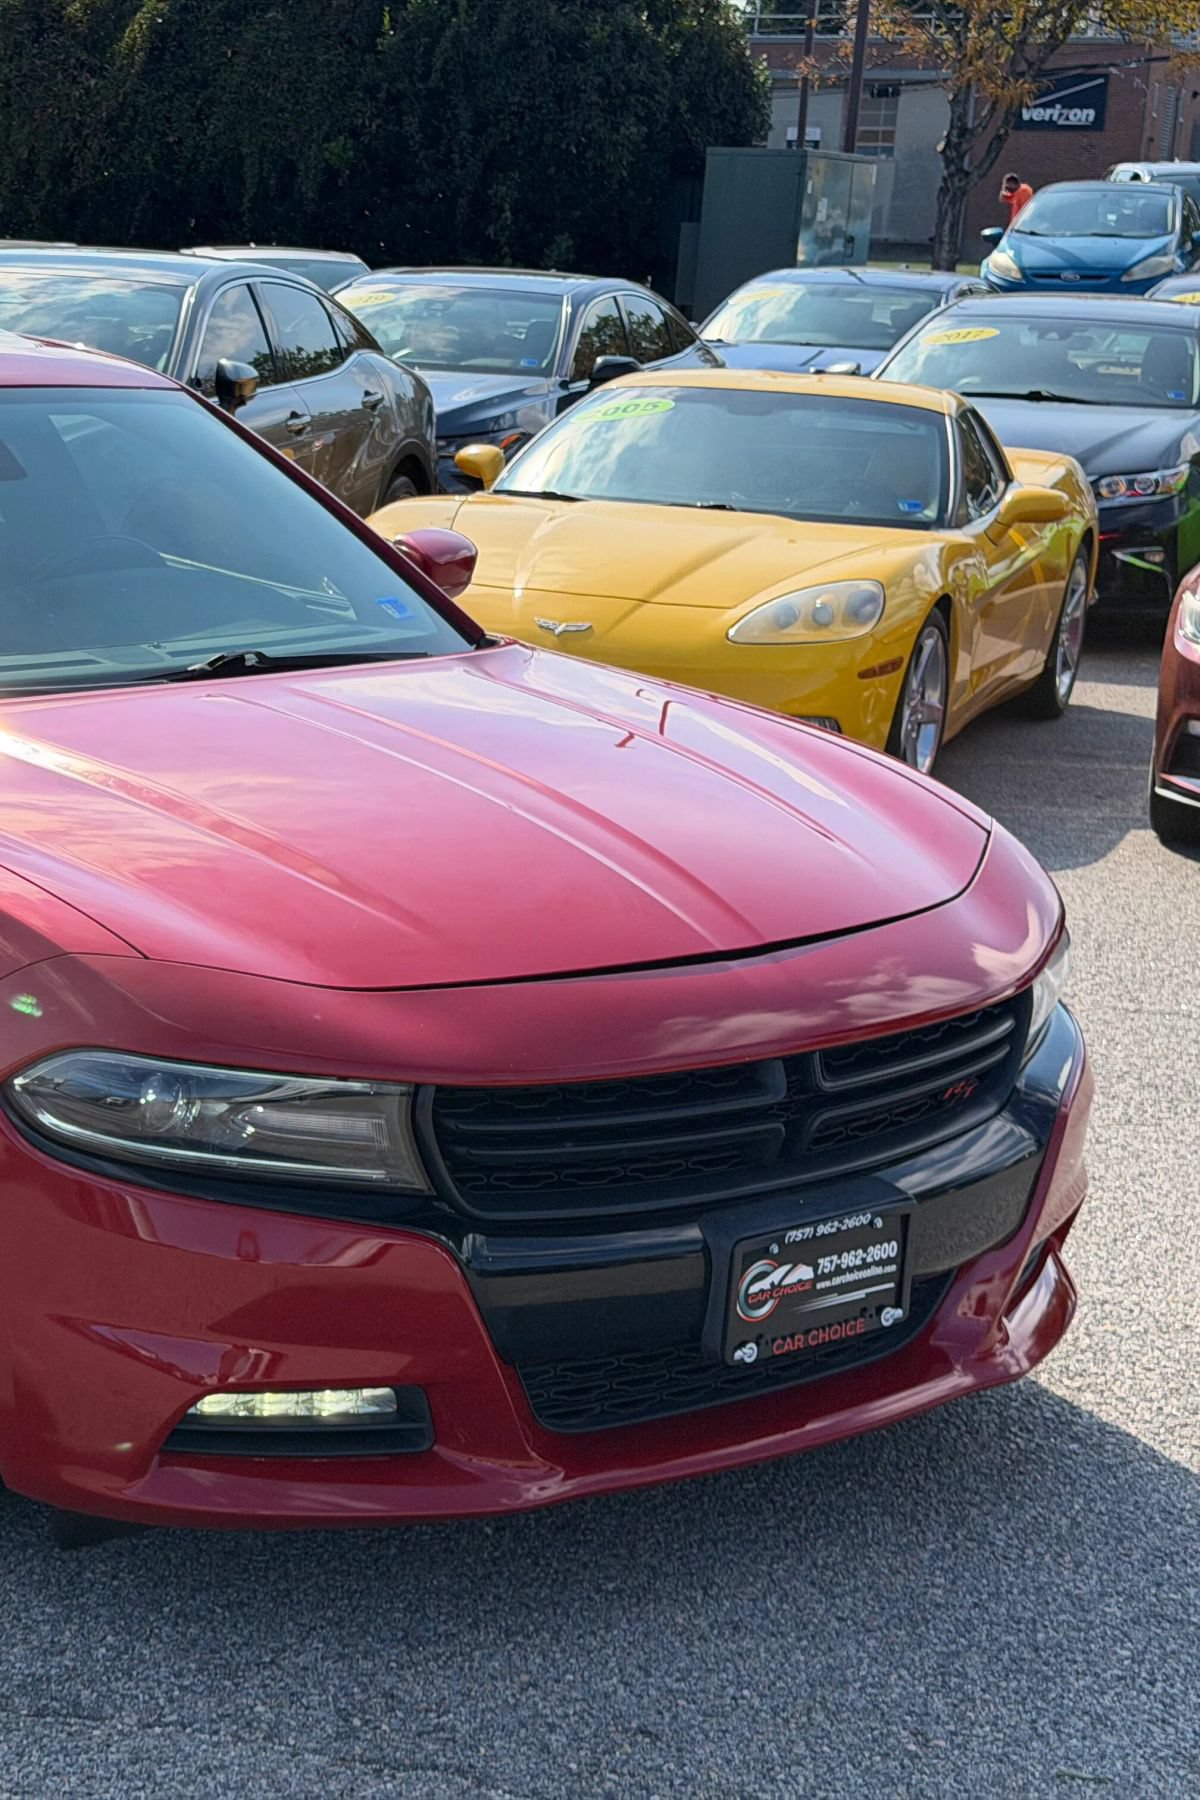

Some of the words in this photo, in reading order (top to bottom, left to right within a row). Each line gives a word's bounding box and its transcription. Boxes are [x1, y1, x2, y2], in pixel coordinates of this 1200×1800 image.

[1021, 103, 1096, 126] verizon
[784, 1227, 815, 1245] (757)
[815, 1213, 872, 1237] 962-2600
[817, 1240, 898, 1276] 757-962-2600
[747, 1292, 772, 1304] CAR
[772, 1279, 814, 1298] CHOICE
[772, 1334, 805, 1355] CAR
[807, 1317, 865, 1346] CHOICE
